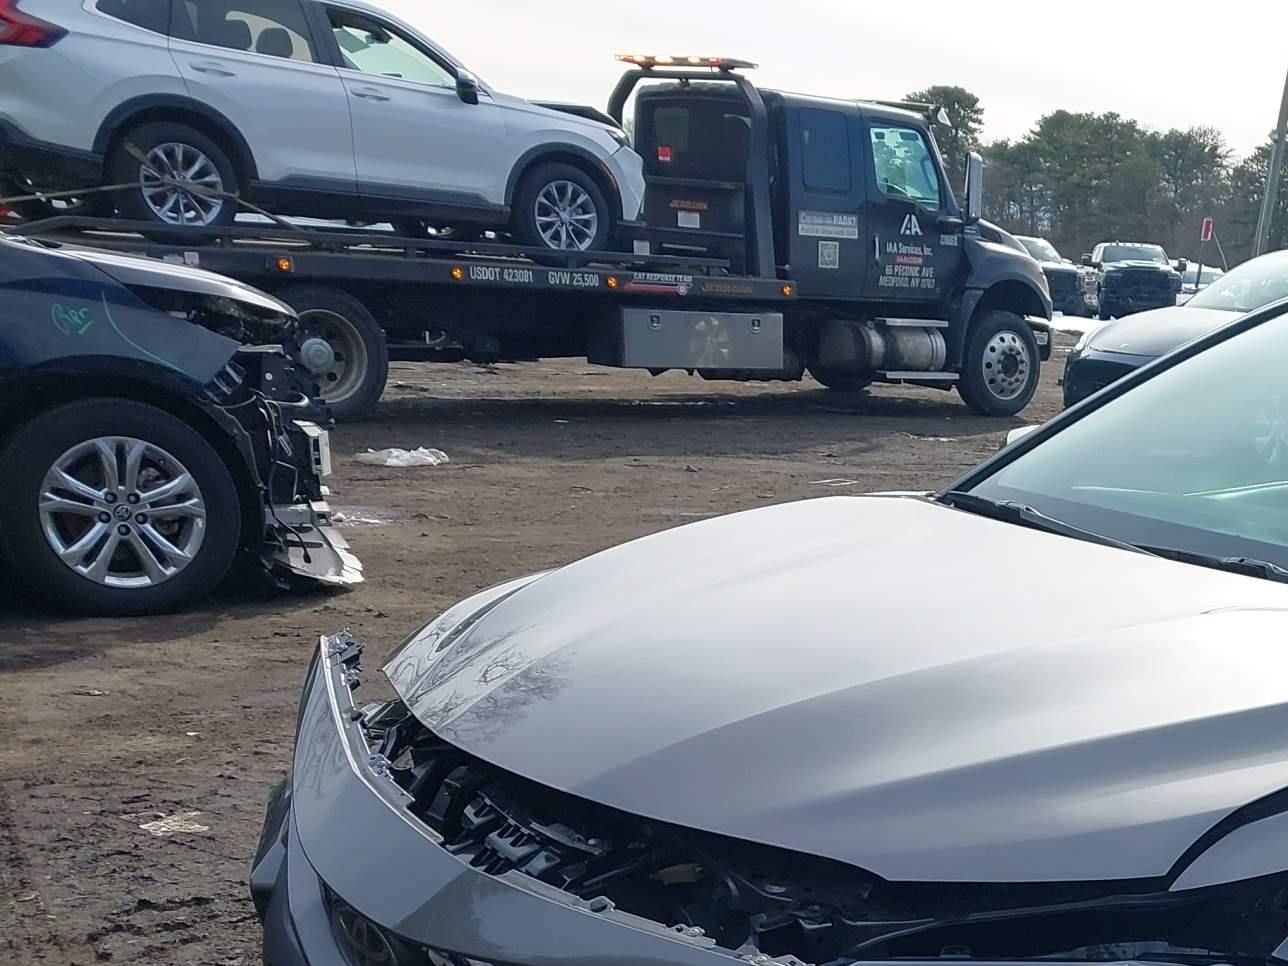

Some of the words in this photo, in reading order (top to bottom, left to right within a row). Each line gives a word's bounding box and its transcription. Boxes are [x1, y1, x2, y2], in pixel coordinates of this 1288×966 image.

[886, 241, 898, 254] IAA
[898, 242, 923, 255] Services,
[923, 244, 933, 256] Inc.
[469, 266, 500, 280] USDOT
[503, 269, 533, 282] 423081
[548, 271, 571, 285] GVW
[572, 273, 600, 287] 25,500
[894, 265, 920, 277] PECONIC
